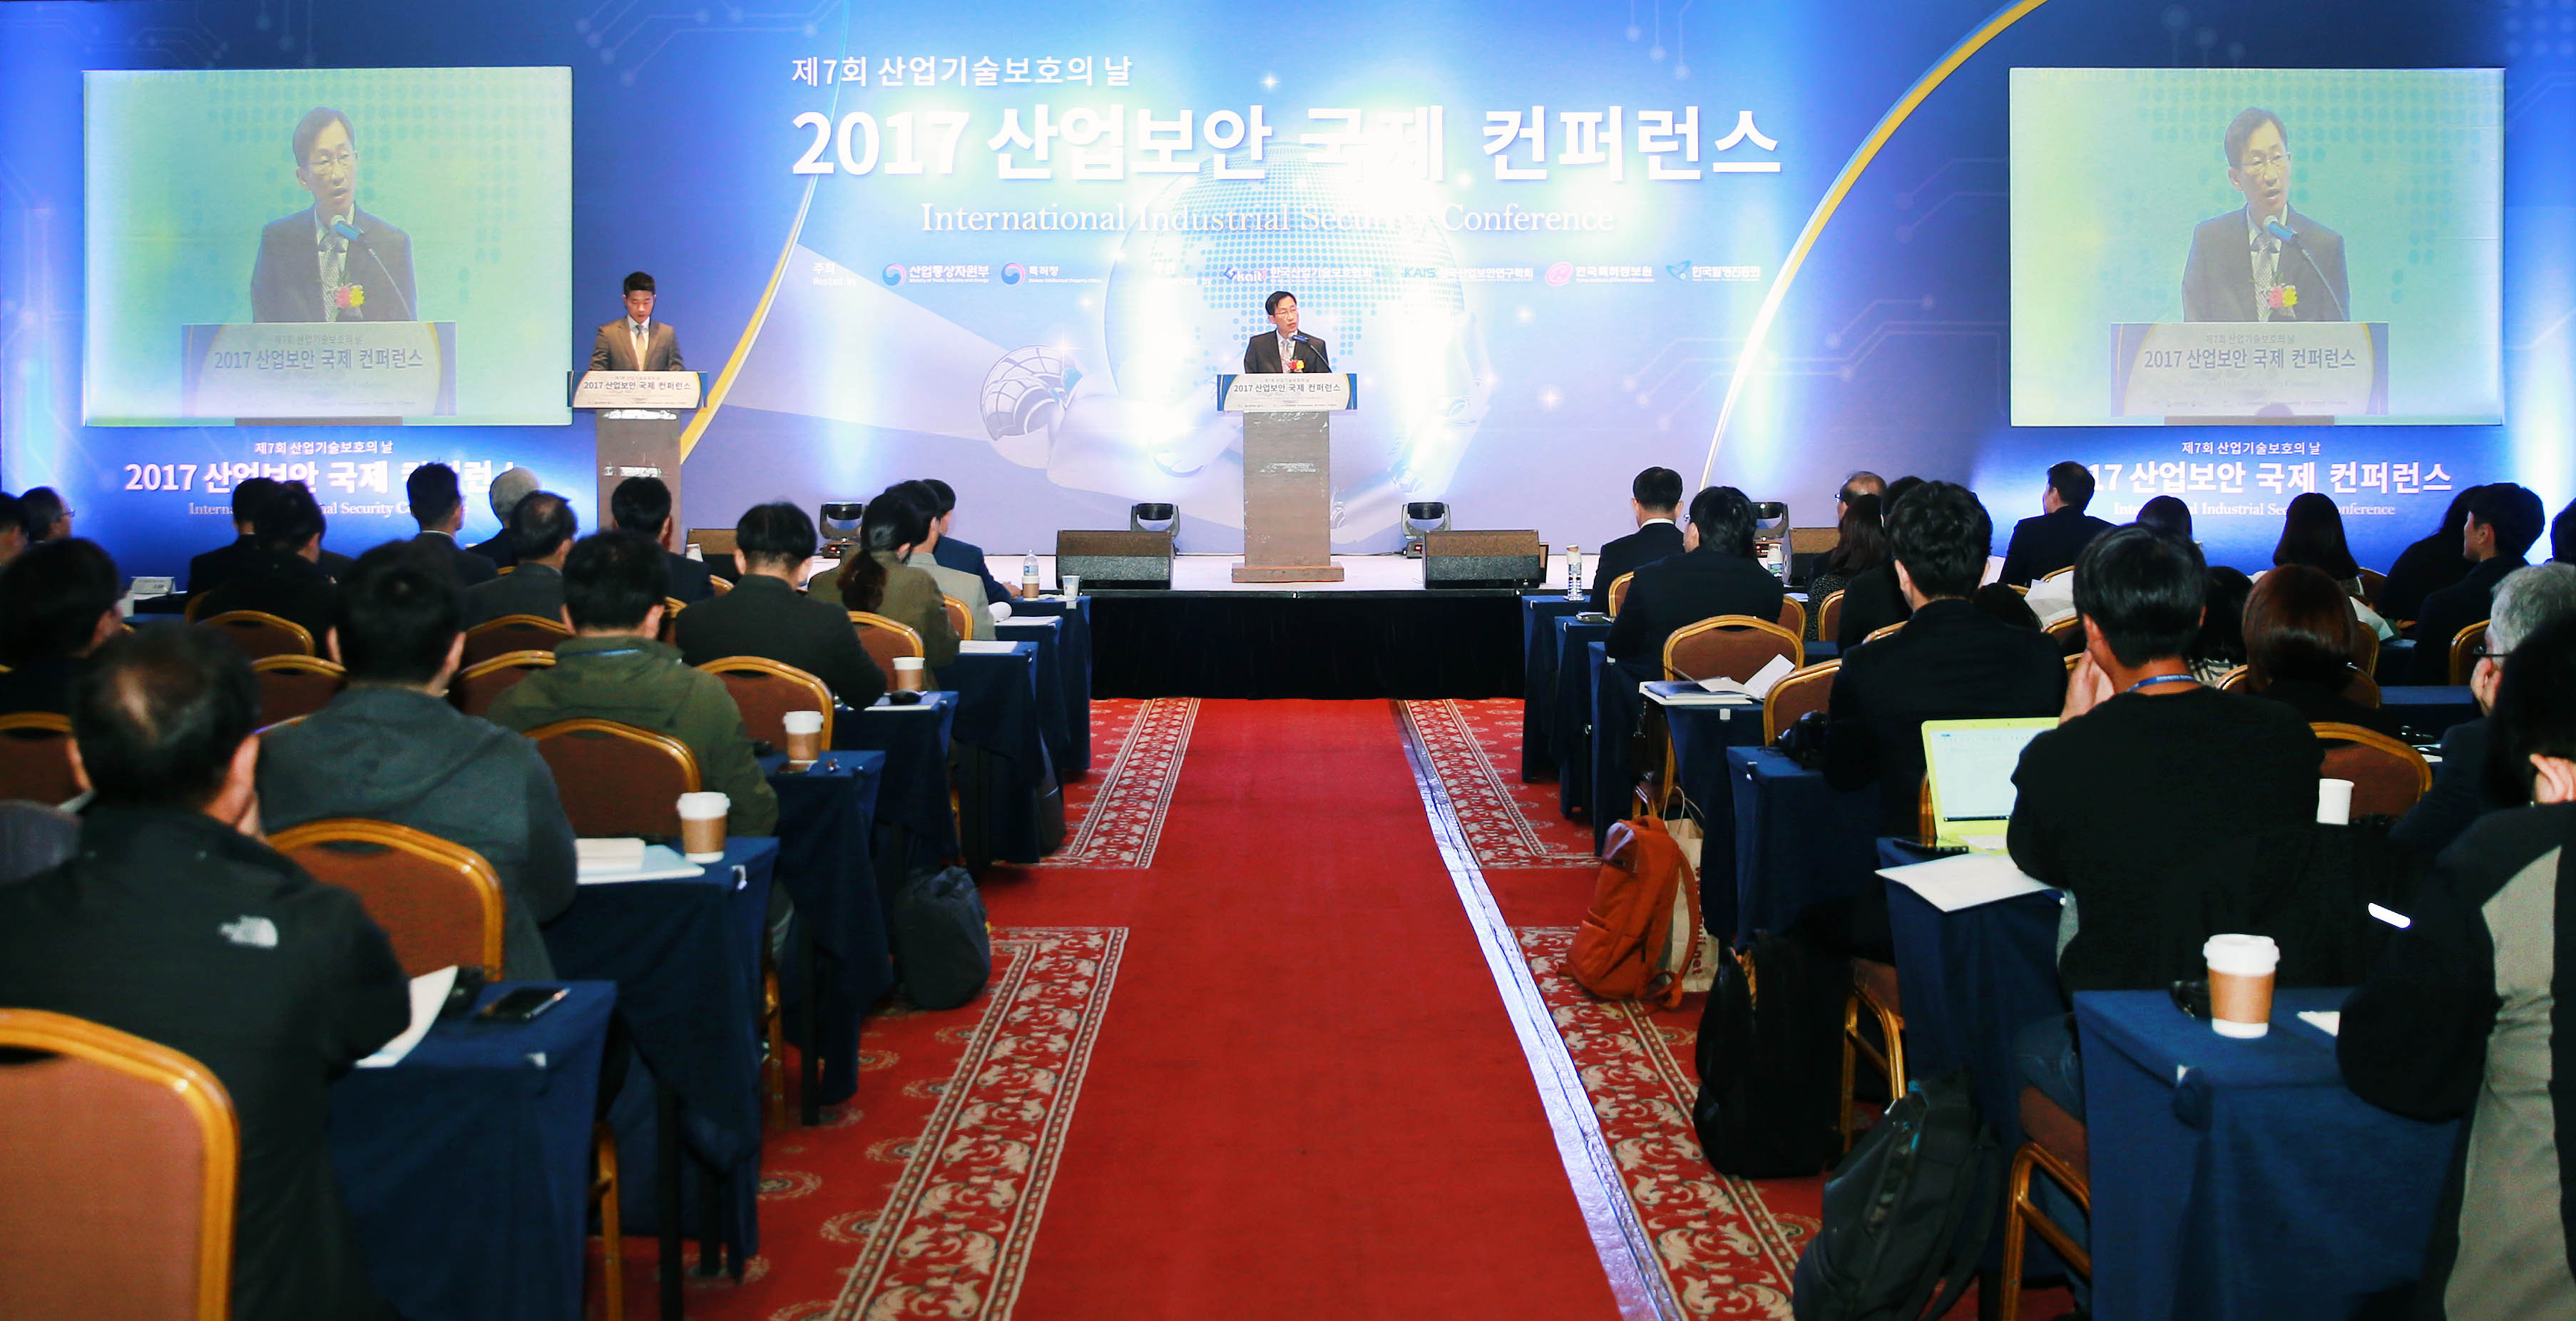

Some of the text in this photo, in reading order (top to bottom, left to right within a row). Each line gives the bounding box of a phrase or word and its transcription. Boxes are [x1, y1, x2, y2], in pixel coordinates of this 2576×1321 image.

[792, 56, 1133, 86] 제7회 산업기술보호의 날
[792, 104, 1782, 181] 2017 산업보안 국제 컨퍼런스
[921, 203, 1615, 240] International Industrial Secury Conference
[910, 265, 989, 278] 산업통상자원부
[1404, 267, 1436, 278] KAIS
[215, 349, 423, 369] 2017 산업보안 국제 컨퍼런스
[2145, 348, 2356, 369] 2017 산업보안 국제 컨퍼런스
[605, 382, 636, 390] 산업보안
[639, 382, 655, 390] 국제
[659, 382, 691, 390] 컨퍼런스
[1255, 384, 1285, 392] 산업보안
[1289, 384, 1304, 392] 국제
[1309, 384, 1341, 392] 컨퍼런스
[255, 441, 393, 454] 제7회 산업기술보호의 날
[2182, 442, 2321, 455] 제7회 산업기술보호의 날
[125, 464, 198, 491] 2017
[327, 460, 388, 494] 국제
[2129, 461, 2247, 494] 산업보안
[2256, 461, 2317, 494] 국제
[2329, 461, 2453, 494] 컨퍼런스
[341, 501, 394, 518] Security
[2202, 501, 2264, 515] Industrial
[2339, 502, 2396, 515] nference
